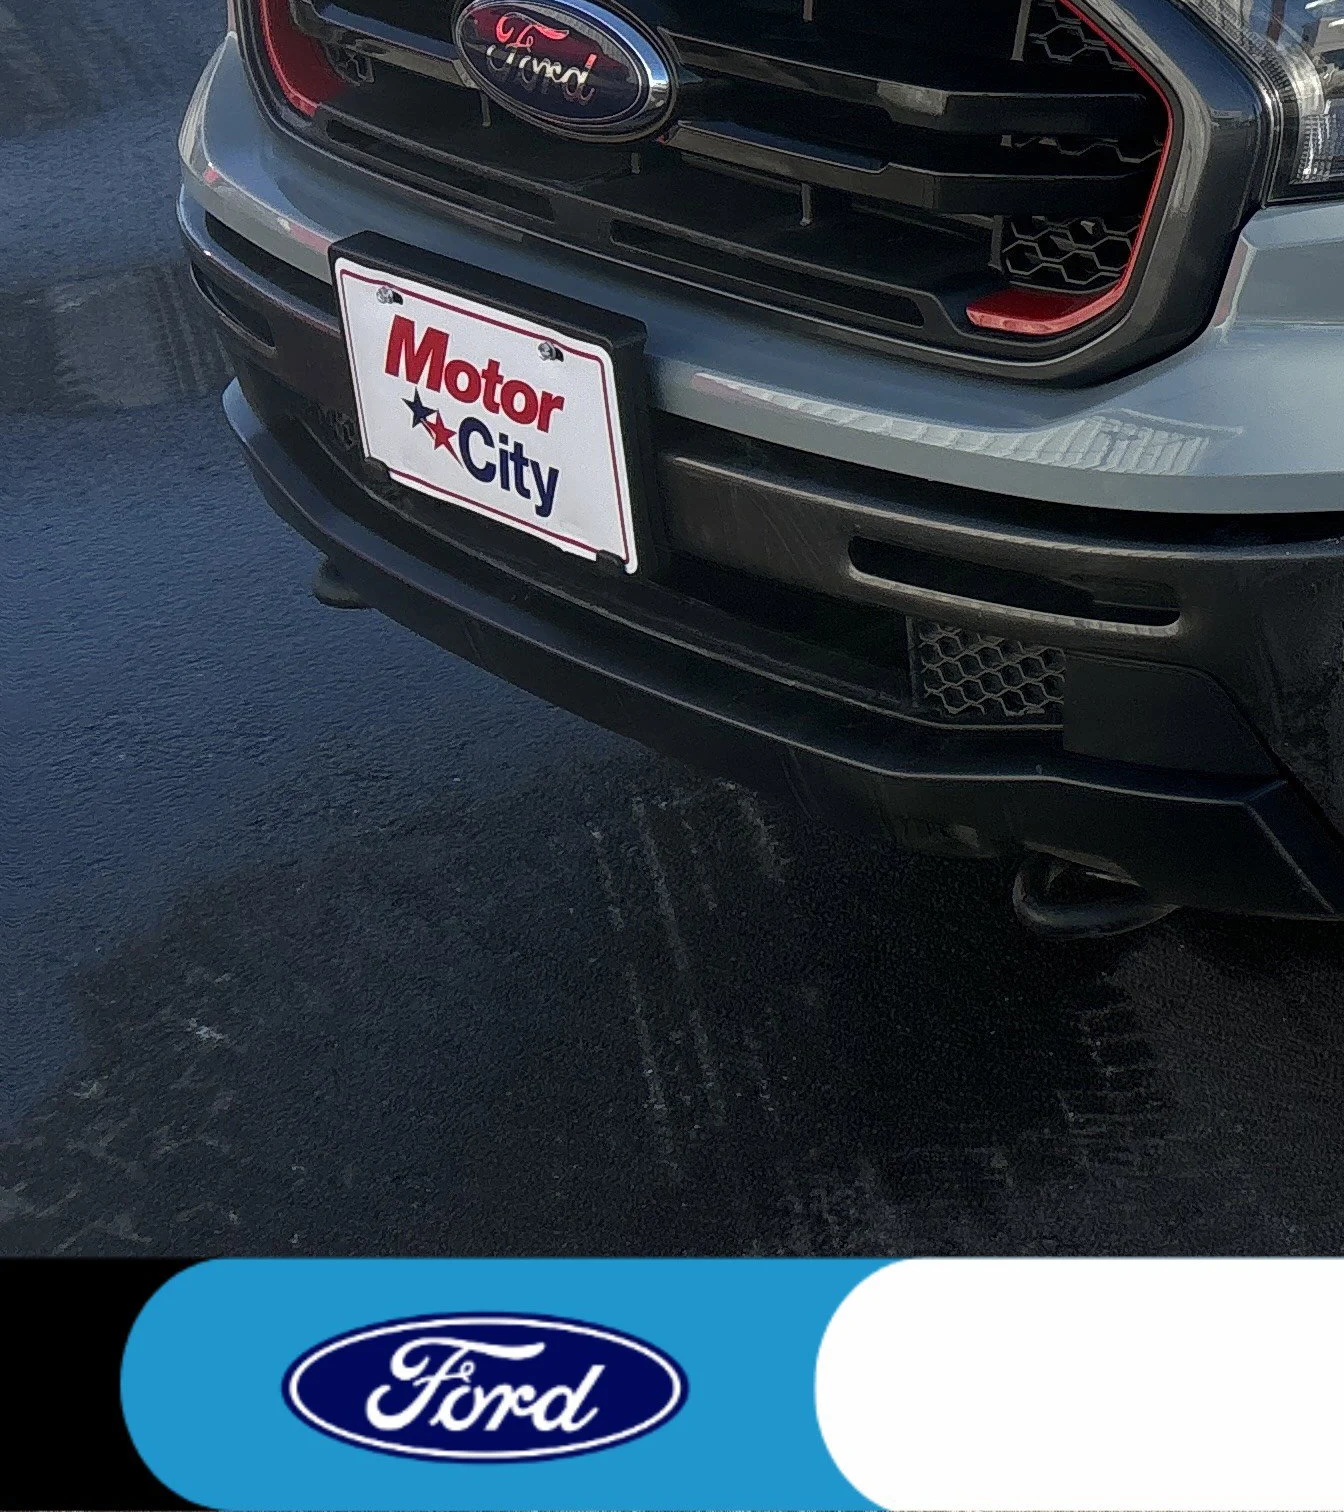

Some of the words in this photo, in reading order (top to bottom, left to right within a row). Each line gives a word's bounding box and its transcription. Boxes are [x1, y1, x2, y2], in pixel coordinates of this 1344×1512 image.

[485, 10, 598, 106] Ford
[384, 313, 564, 433] Motor
[457, 416, 560, 518] City
